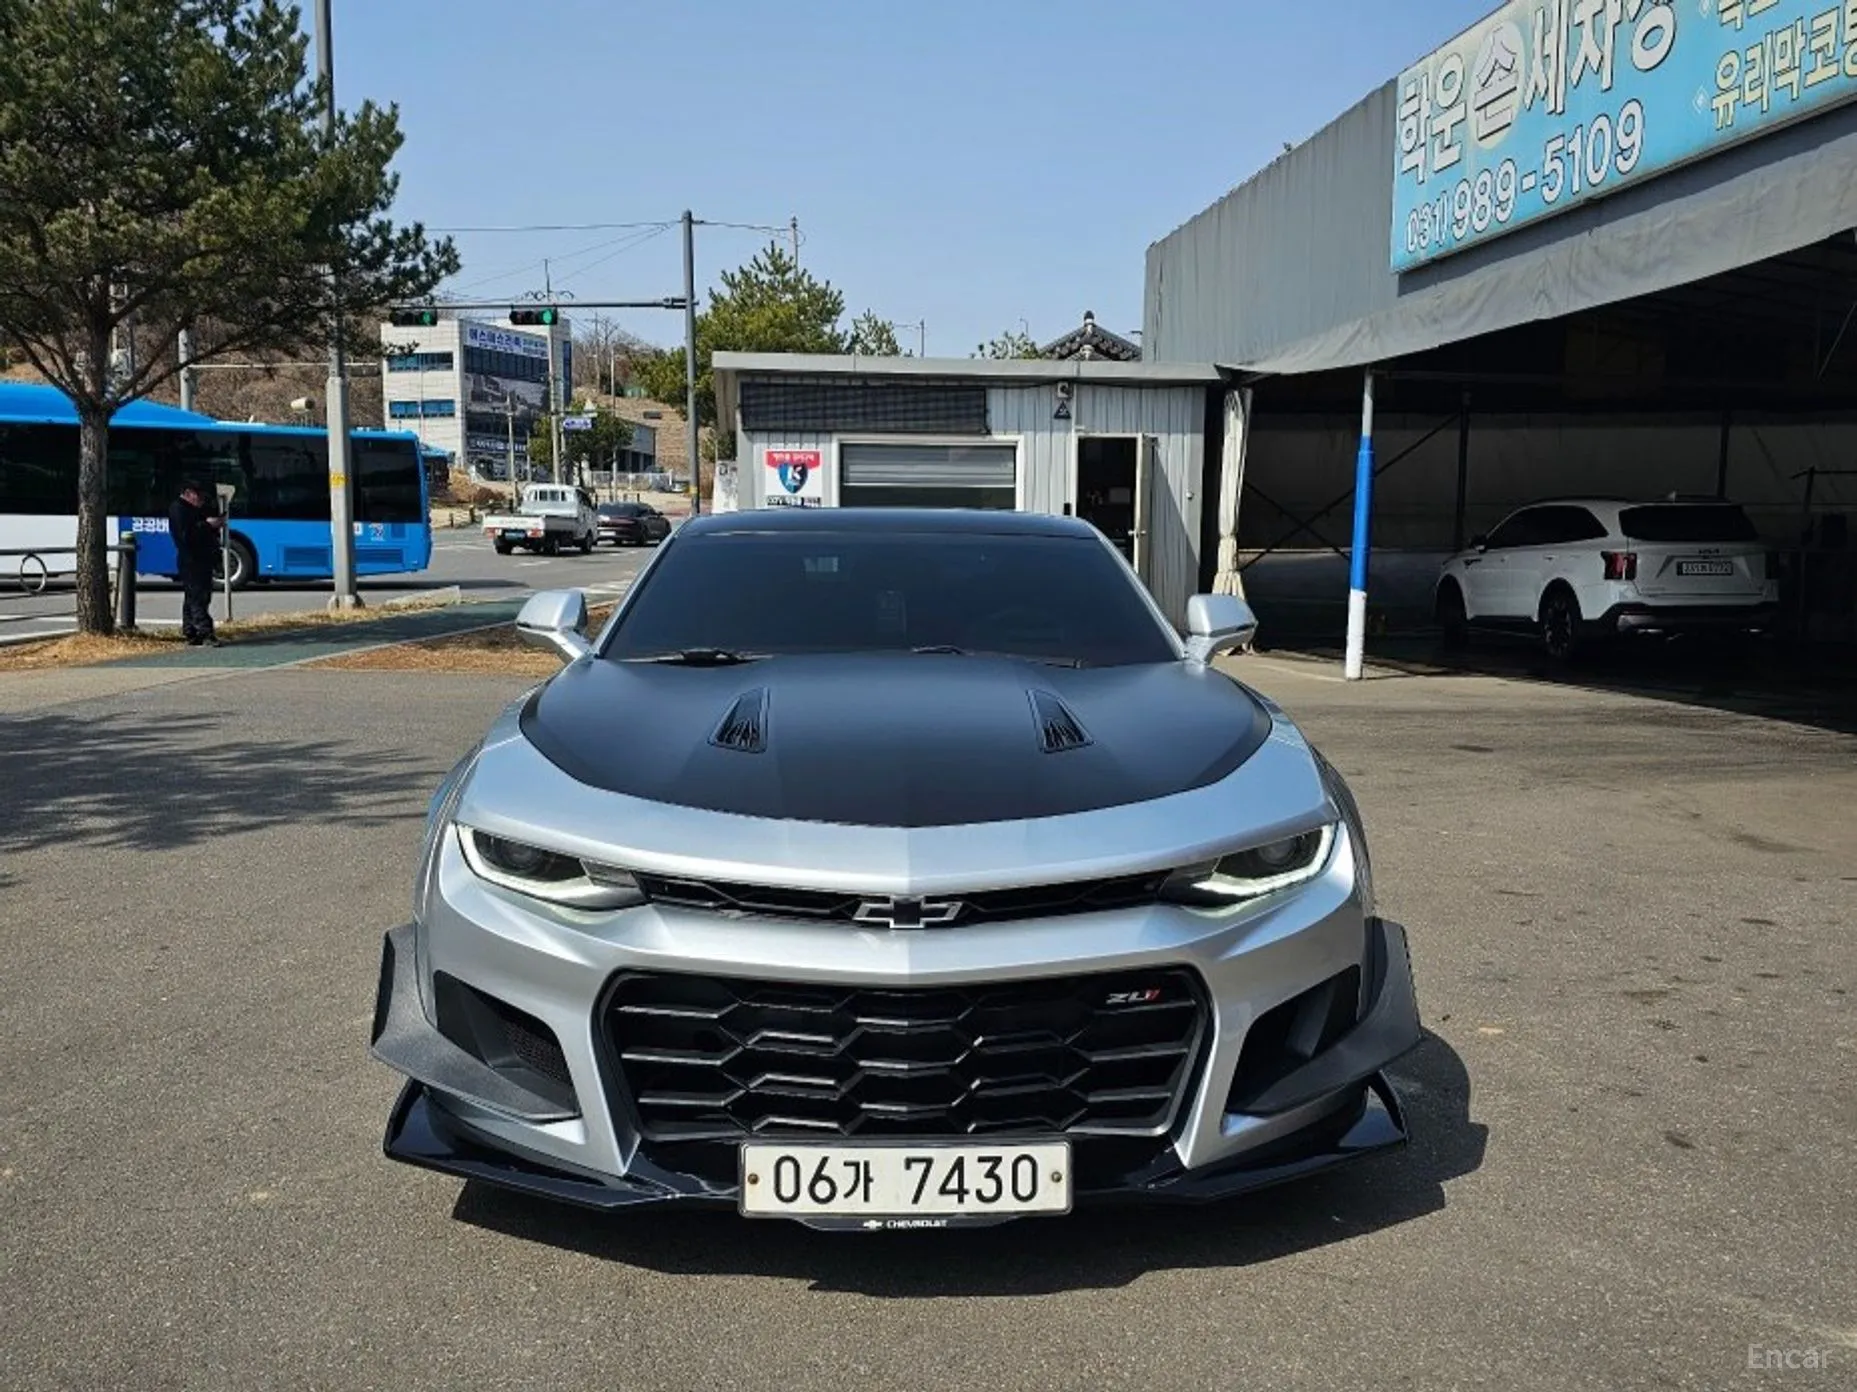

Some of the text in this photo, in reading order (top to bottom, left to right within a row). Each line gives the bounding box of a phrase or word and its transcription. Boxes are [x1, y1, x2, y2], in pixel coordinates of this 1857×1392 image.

[132, 516, 170, 533] 공공버
[773, 1153, 1038, 1205] 06가 7430
[886, 1219, 948, 1230] CHEVROLET
